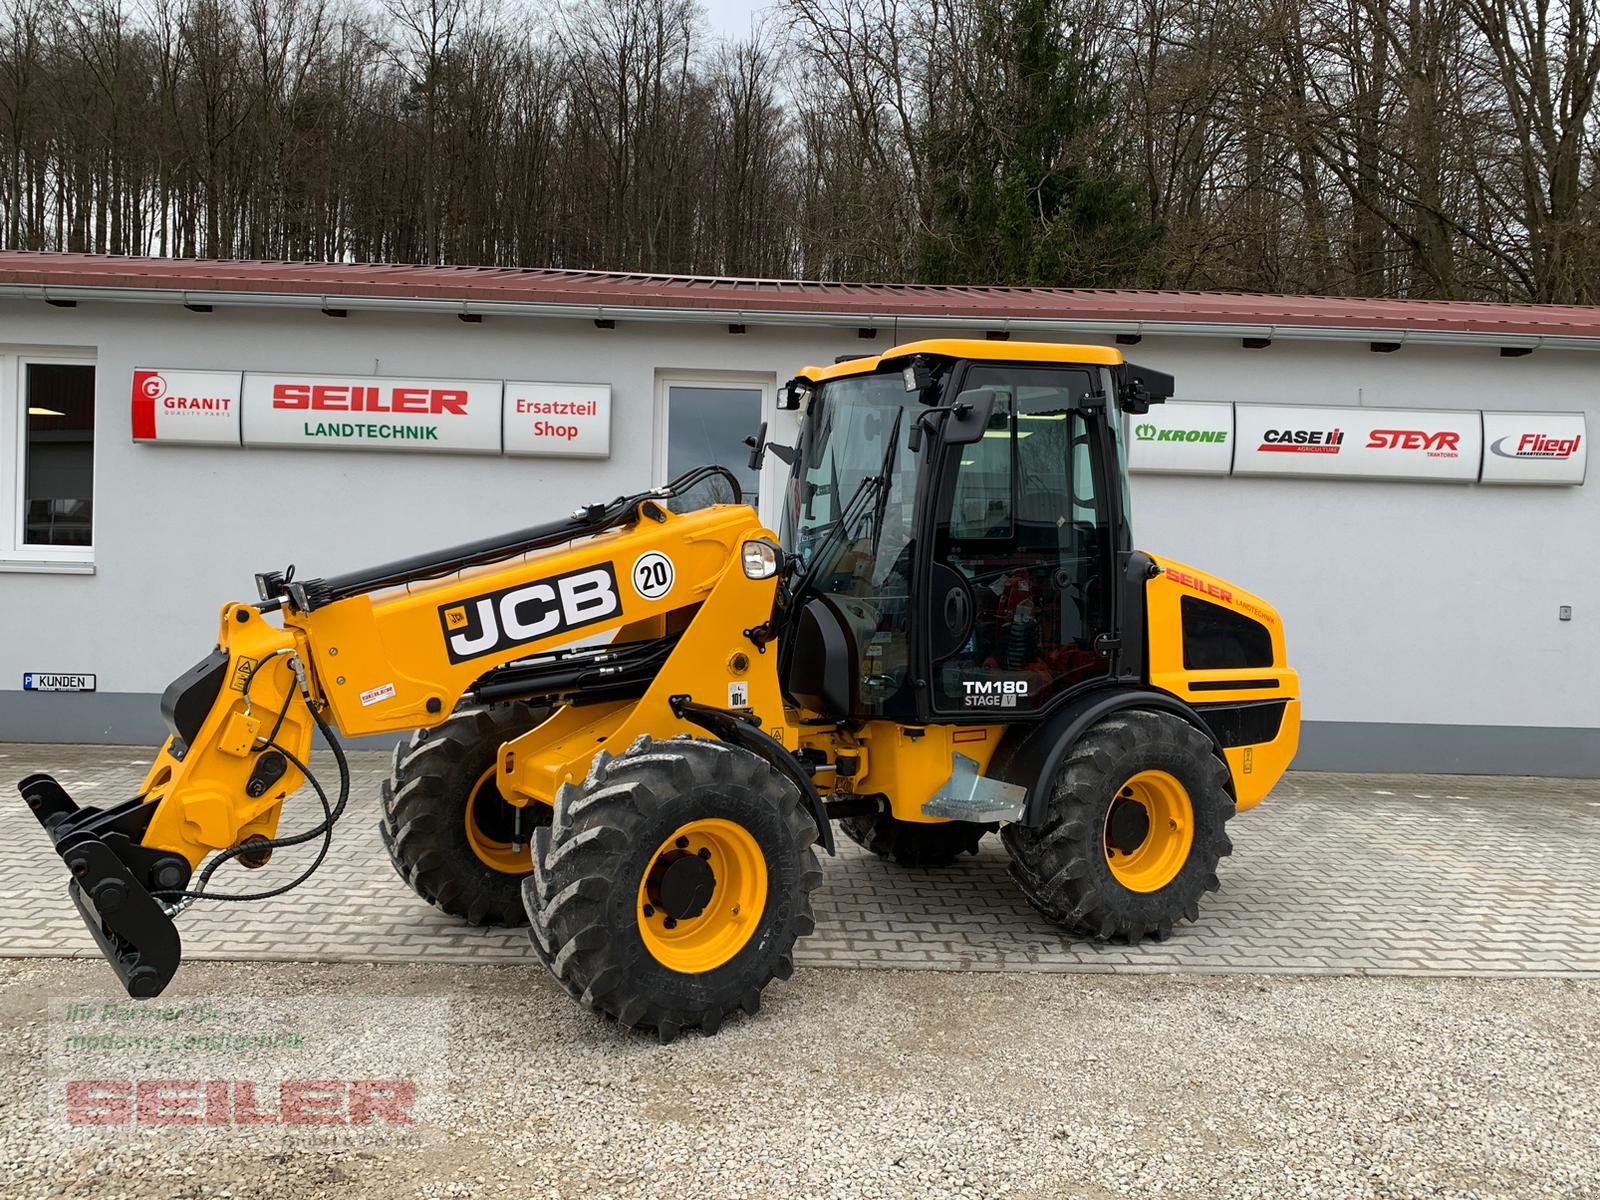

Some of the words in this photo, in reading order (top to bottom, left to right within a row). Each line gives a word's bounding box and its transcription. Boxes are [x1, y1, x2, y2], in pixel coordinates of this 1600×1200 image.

[163, 397, 231, 410] GRANIT
[272, 384, 468, 415] SEILER
[516, 399, 597, 416] Ersatzteil
[304, 422, 438, 440] LANDTECHNIK
[534, 421, 578, 441] Shop
[1157, 429, 1228, 443] KRONE
[1263, 429, 1323, 444] CASE
[1365, 430, 1460, 450] STEYR
[1517, 433, 1582, 457] Fliegl
[639, 561, 669, 591] 20
[1166, 567, 1233, 604] SEILER
[1235, 599, 1275, 624] LANDTECHNIK
[450, 569, 617, 656] JCB
[25, 676, 32, 684] P
[39, 675, 85, 687] KUNDEN
[962, 681, 1028, 694] TM180
[732, 692, 742, 705] 101
[965, 695, 1000, 706] STAGE
